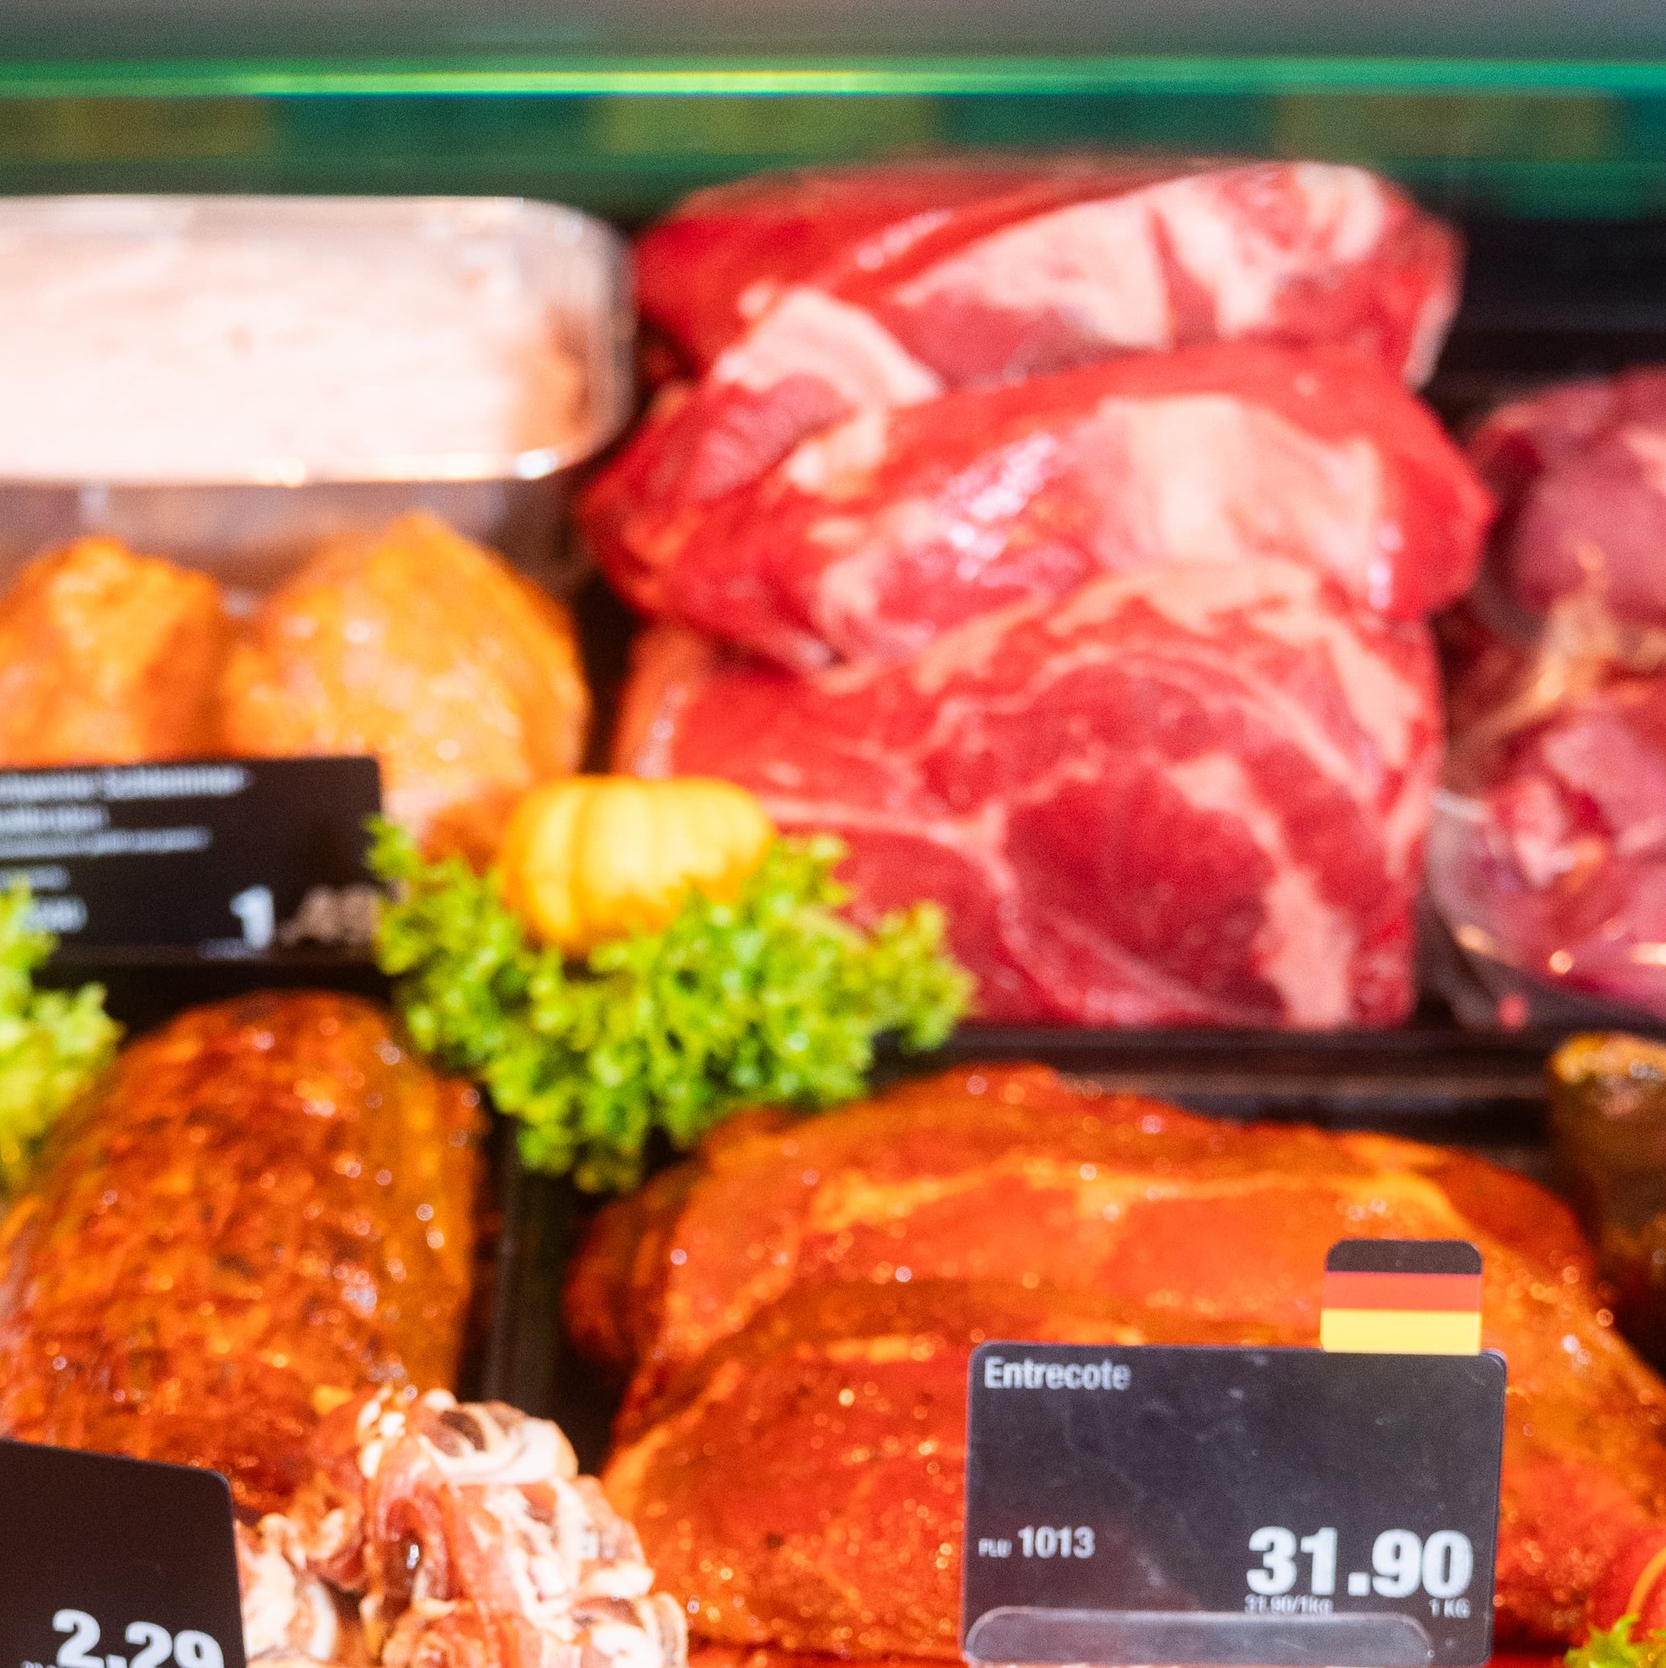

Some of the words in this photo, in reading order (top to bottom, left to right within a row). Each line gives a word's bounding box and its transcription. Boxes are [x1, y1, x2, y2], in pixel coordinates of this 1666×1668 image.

[985, 1355, 1130, 1391] Entrecote
[1018, 1525, 1096, 1559] 1013
[1246, 1526, 1474, 1598] 31.90
